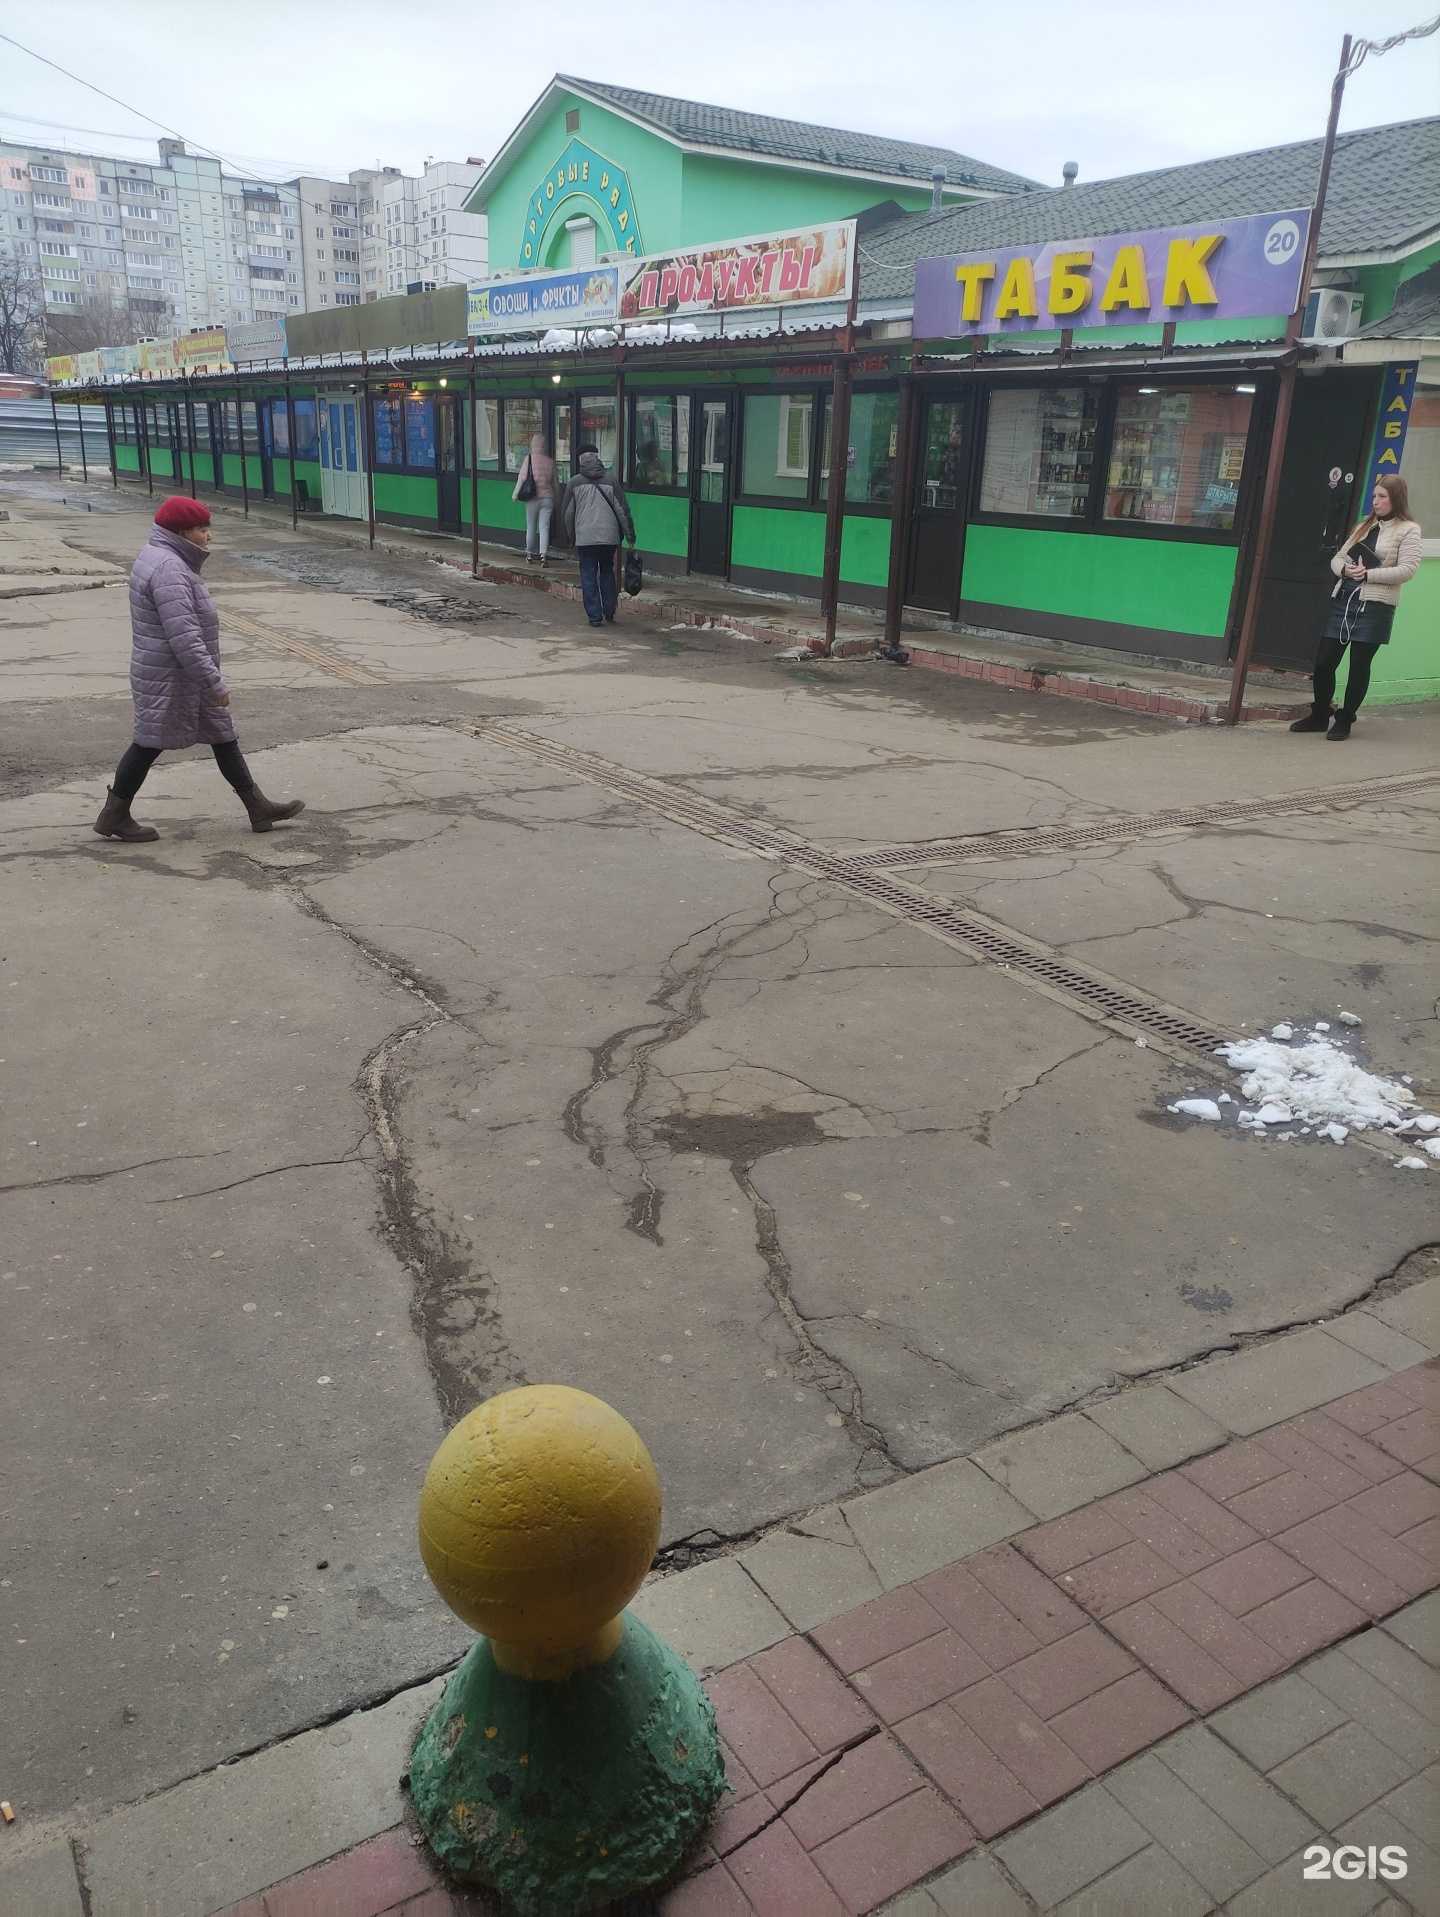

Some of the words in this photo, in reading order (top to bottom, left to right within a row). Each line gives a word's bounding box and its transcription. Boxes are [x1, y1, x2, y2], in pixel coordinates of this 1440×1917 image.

[524, 160, 590, 259] ОРГОВЫЕ
[1268, 231, 1296, 254] 20
[493, 291, 529, 316] ОВОЩИ
[541, 284, 580, 309] ФРУКТЫ
[638, 246, 816, 310] ПРОДУКТЫ
[955, 235, 1226, 321] ТАБАК
[1375, 367, 1416, 484] ТАБА
